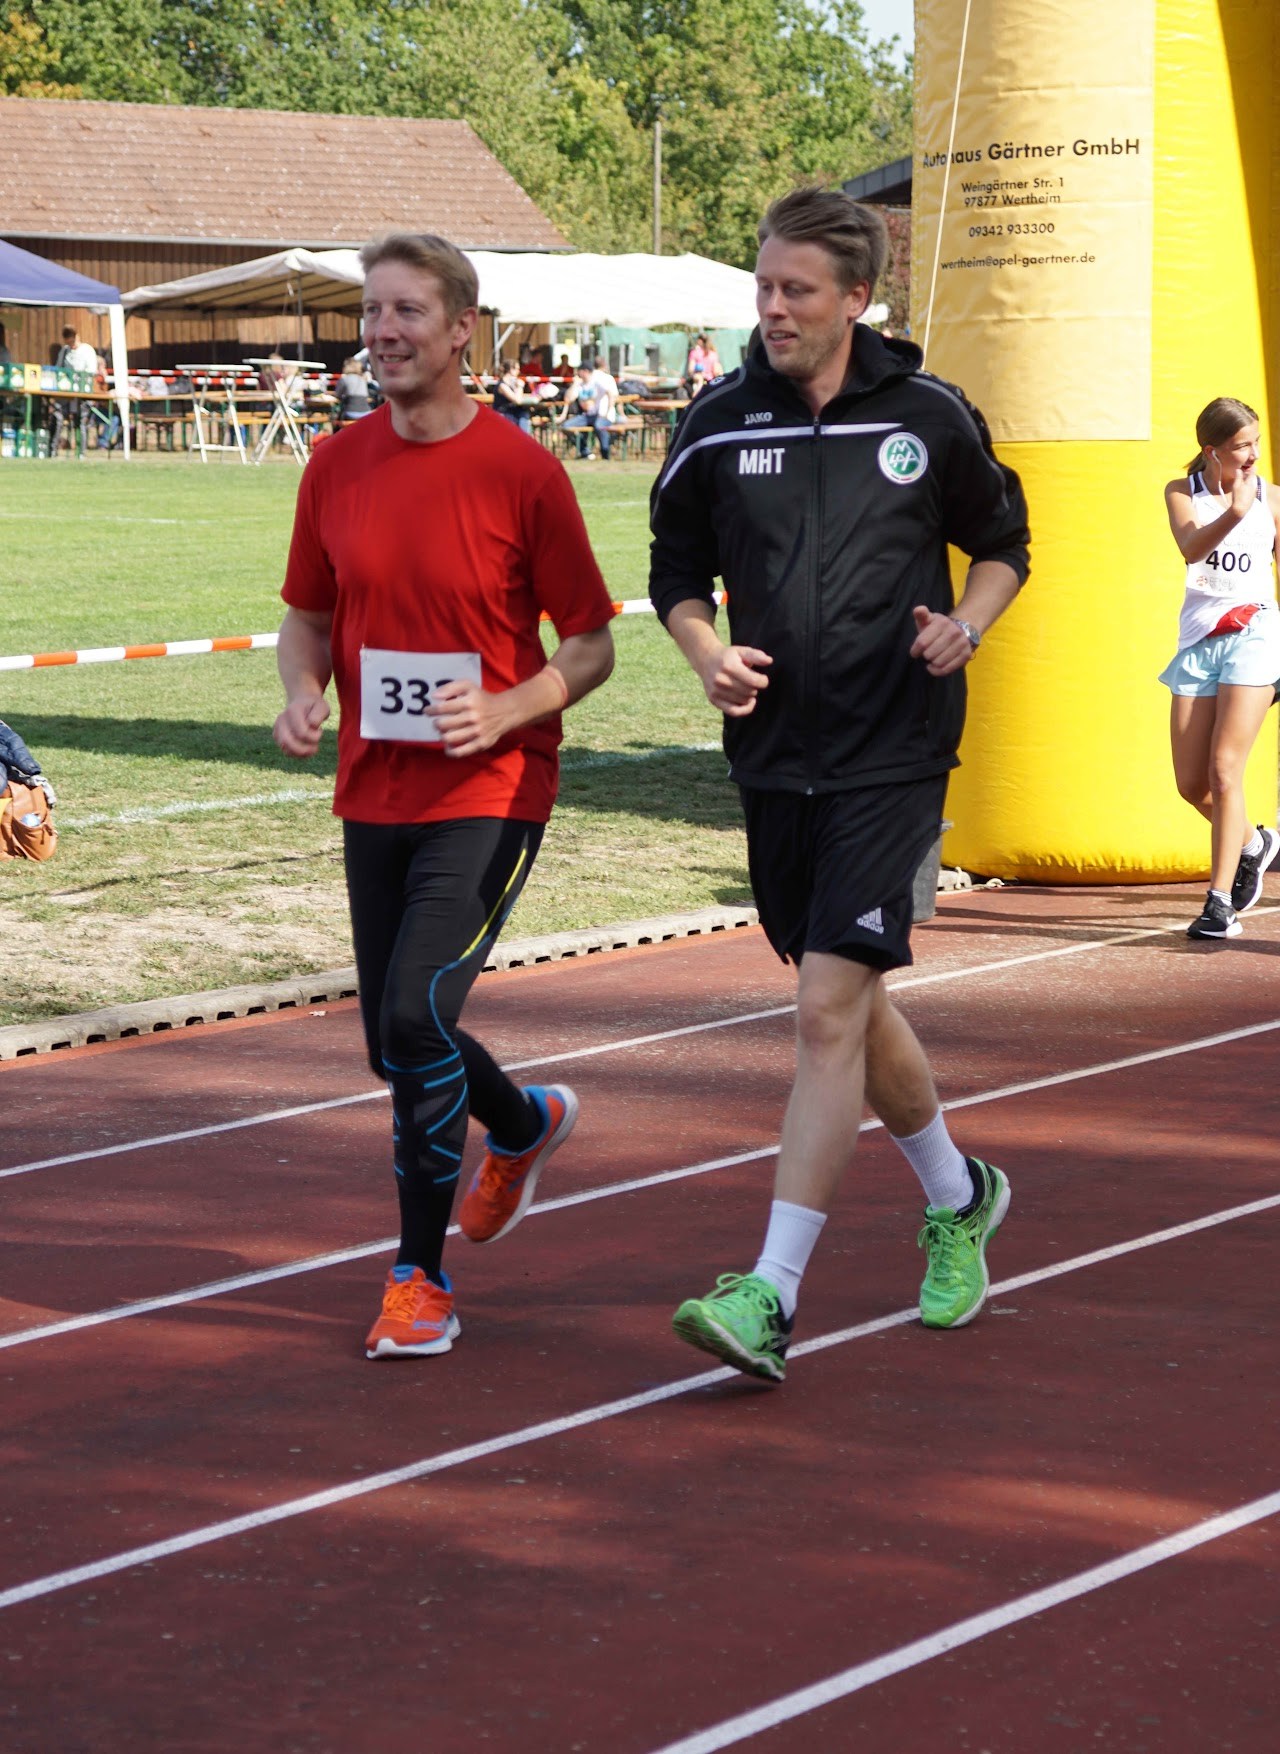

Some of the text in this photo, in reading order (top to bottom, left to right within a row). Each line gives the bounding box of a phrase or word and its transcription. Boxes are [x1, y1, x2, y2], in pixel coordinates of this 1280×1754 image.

[988, 142, 1065, 161] Gärtner
[1072, 138, 1140, 156] GmbH
[961, 177, 1065, 195] Weingärtner Str. 1
[964, 194, 1062, 208] 97877 Wertheim
[969, 223, 1056, 238] 09342 933300
[941, 252, 1096, 271] wertheim@opel-gaertner.de
[744, 412, 773, 425] JAKO
[739, 448, 785, 475] MHT
[1205, 550, 1252, 573] 400
[380, 677, 455, 716] 33
